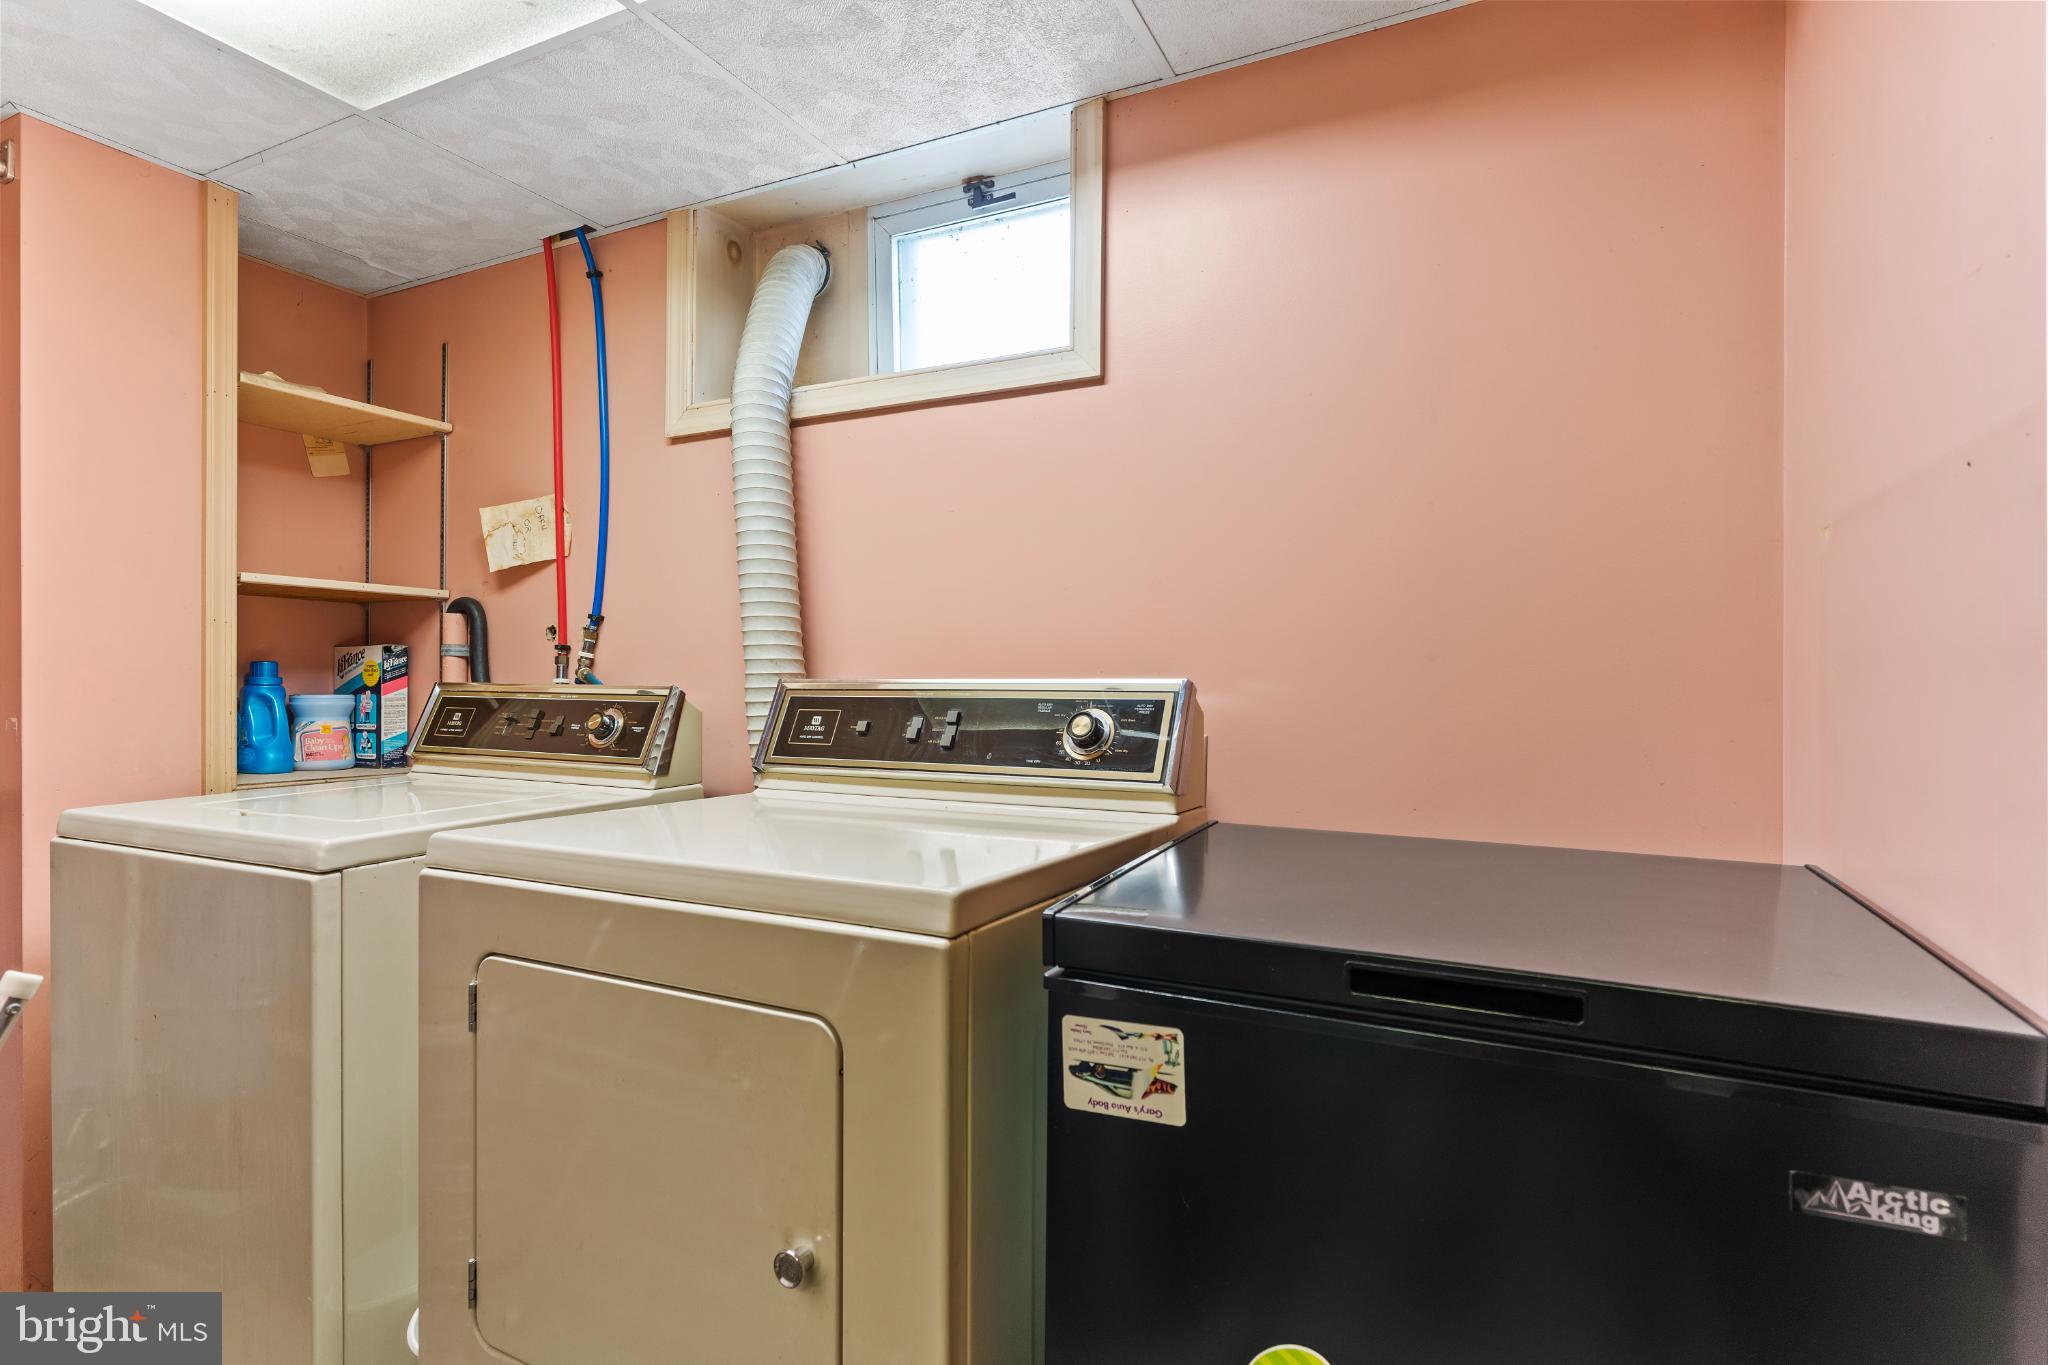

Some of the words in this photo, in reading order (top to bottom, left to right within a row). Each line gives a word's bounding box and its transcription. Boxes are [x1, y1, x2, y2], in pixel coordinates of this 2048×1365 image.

[304, 736, 324, 745] Baby
[1088, 1097, 1109, 1111] Body
[1111, 1102, 1131, 1113] Auto
[1134, 1105, 1163, 1119] Gary's
[1847, 1181, 1951, 1215] Arctic
[1871, 1203, 1941, 1235] King
